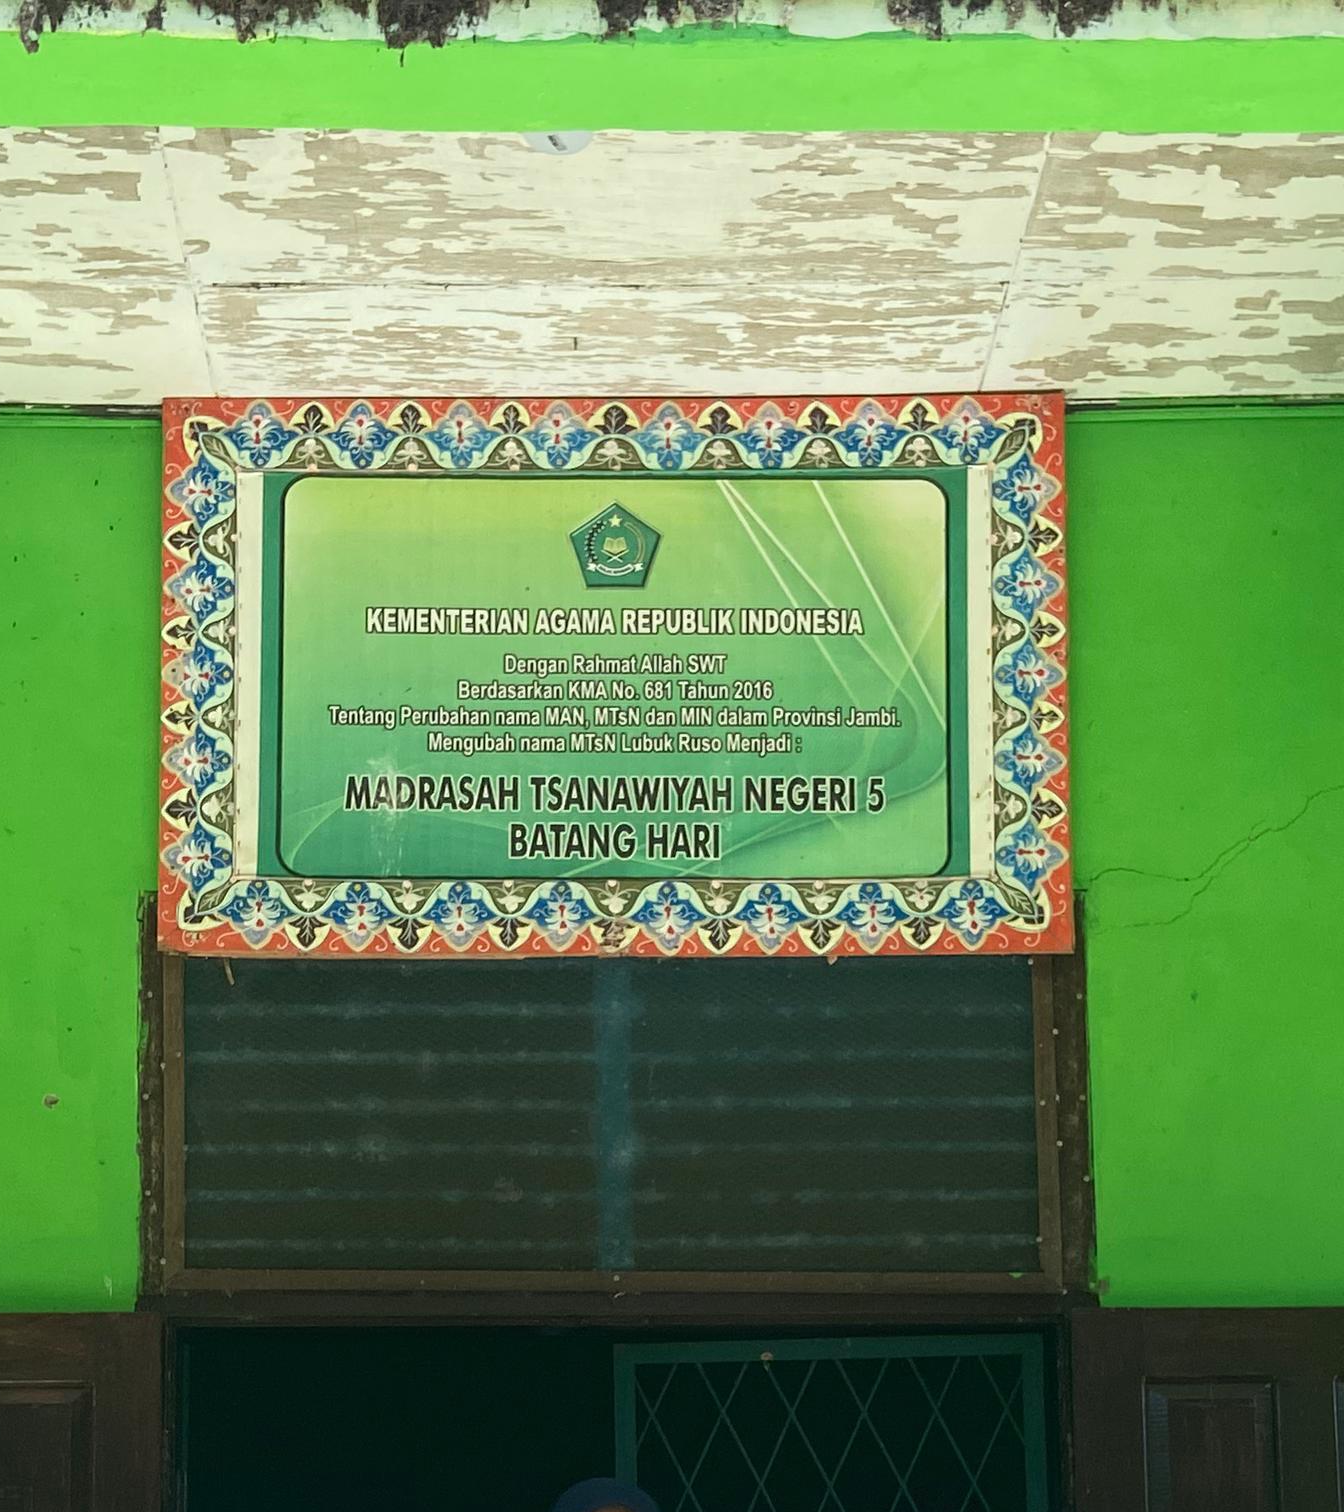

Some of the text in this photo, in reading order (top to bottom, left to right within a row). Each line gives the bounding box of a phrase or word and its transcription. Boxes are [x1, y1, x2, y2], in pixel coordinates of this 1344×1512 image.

[366, 608, 864, 634] KEMENTERIAN AGAMA REPUBLIK INDONESIA
[504, 655, 726, 676] Dengan Rahmat Allah SWT
[458, 680, 772, 700] Berdasarkan KMA No. 681 Tahun 2016
[329, 706, 901, 729] Tentang Perubahan nama MAN, MTsN dan MIN dalam Provinsi Jambi.
[428, 733, 514, 755] Mengubah
[521, 738, 565, 751] nama
[570, 734, 616, 751] MTsN
[621, 734, 673, 752] Lubuk
[678, 735, 721, 752] Ruso
[726, 735, 791, 756] Menjadi
[344, 776, 885, 814] MADRASAH TSANAWIYAH NEGERI 5
[508, 823, 720, 860] BATANG HARI
